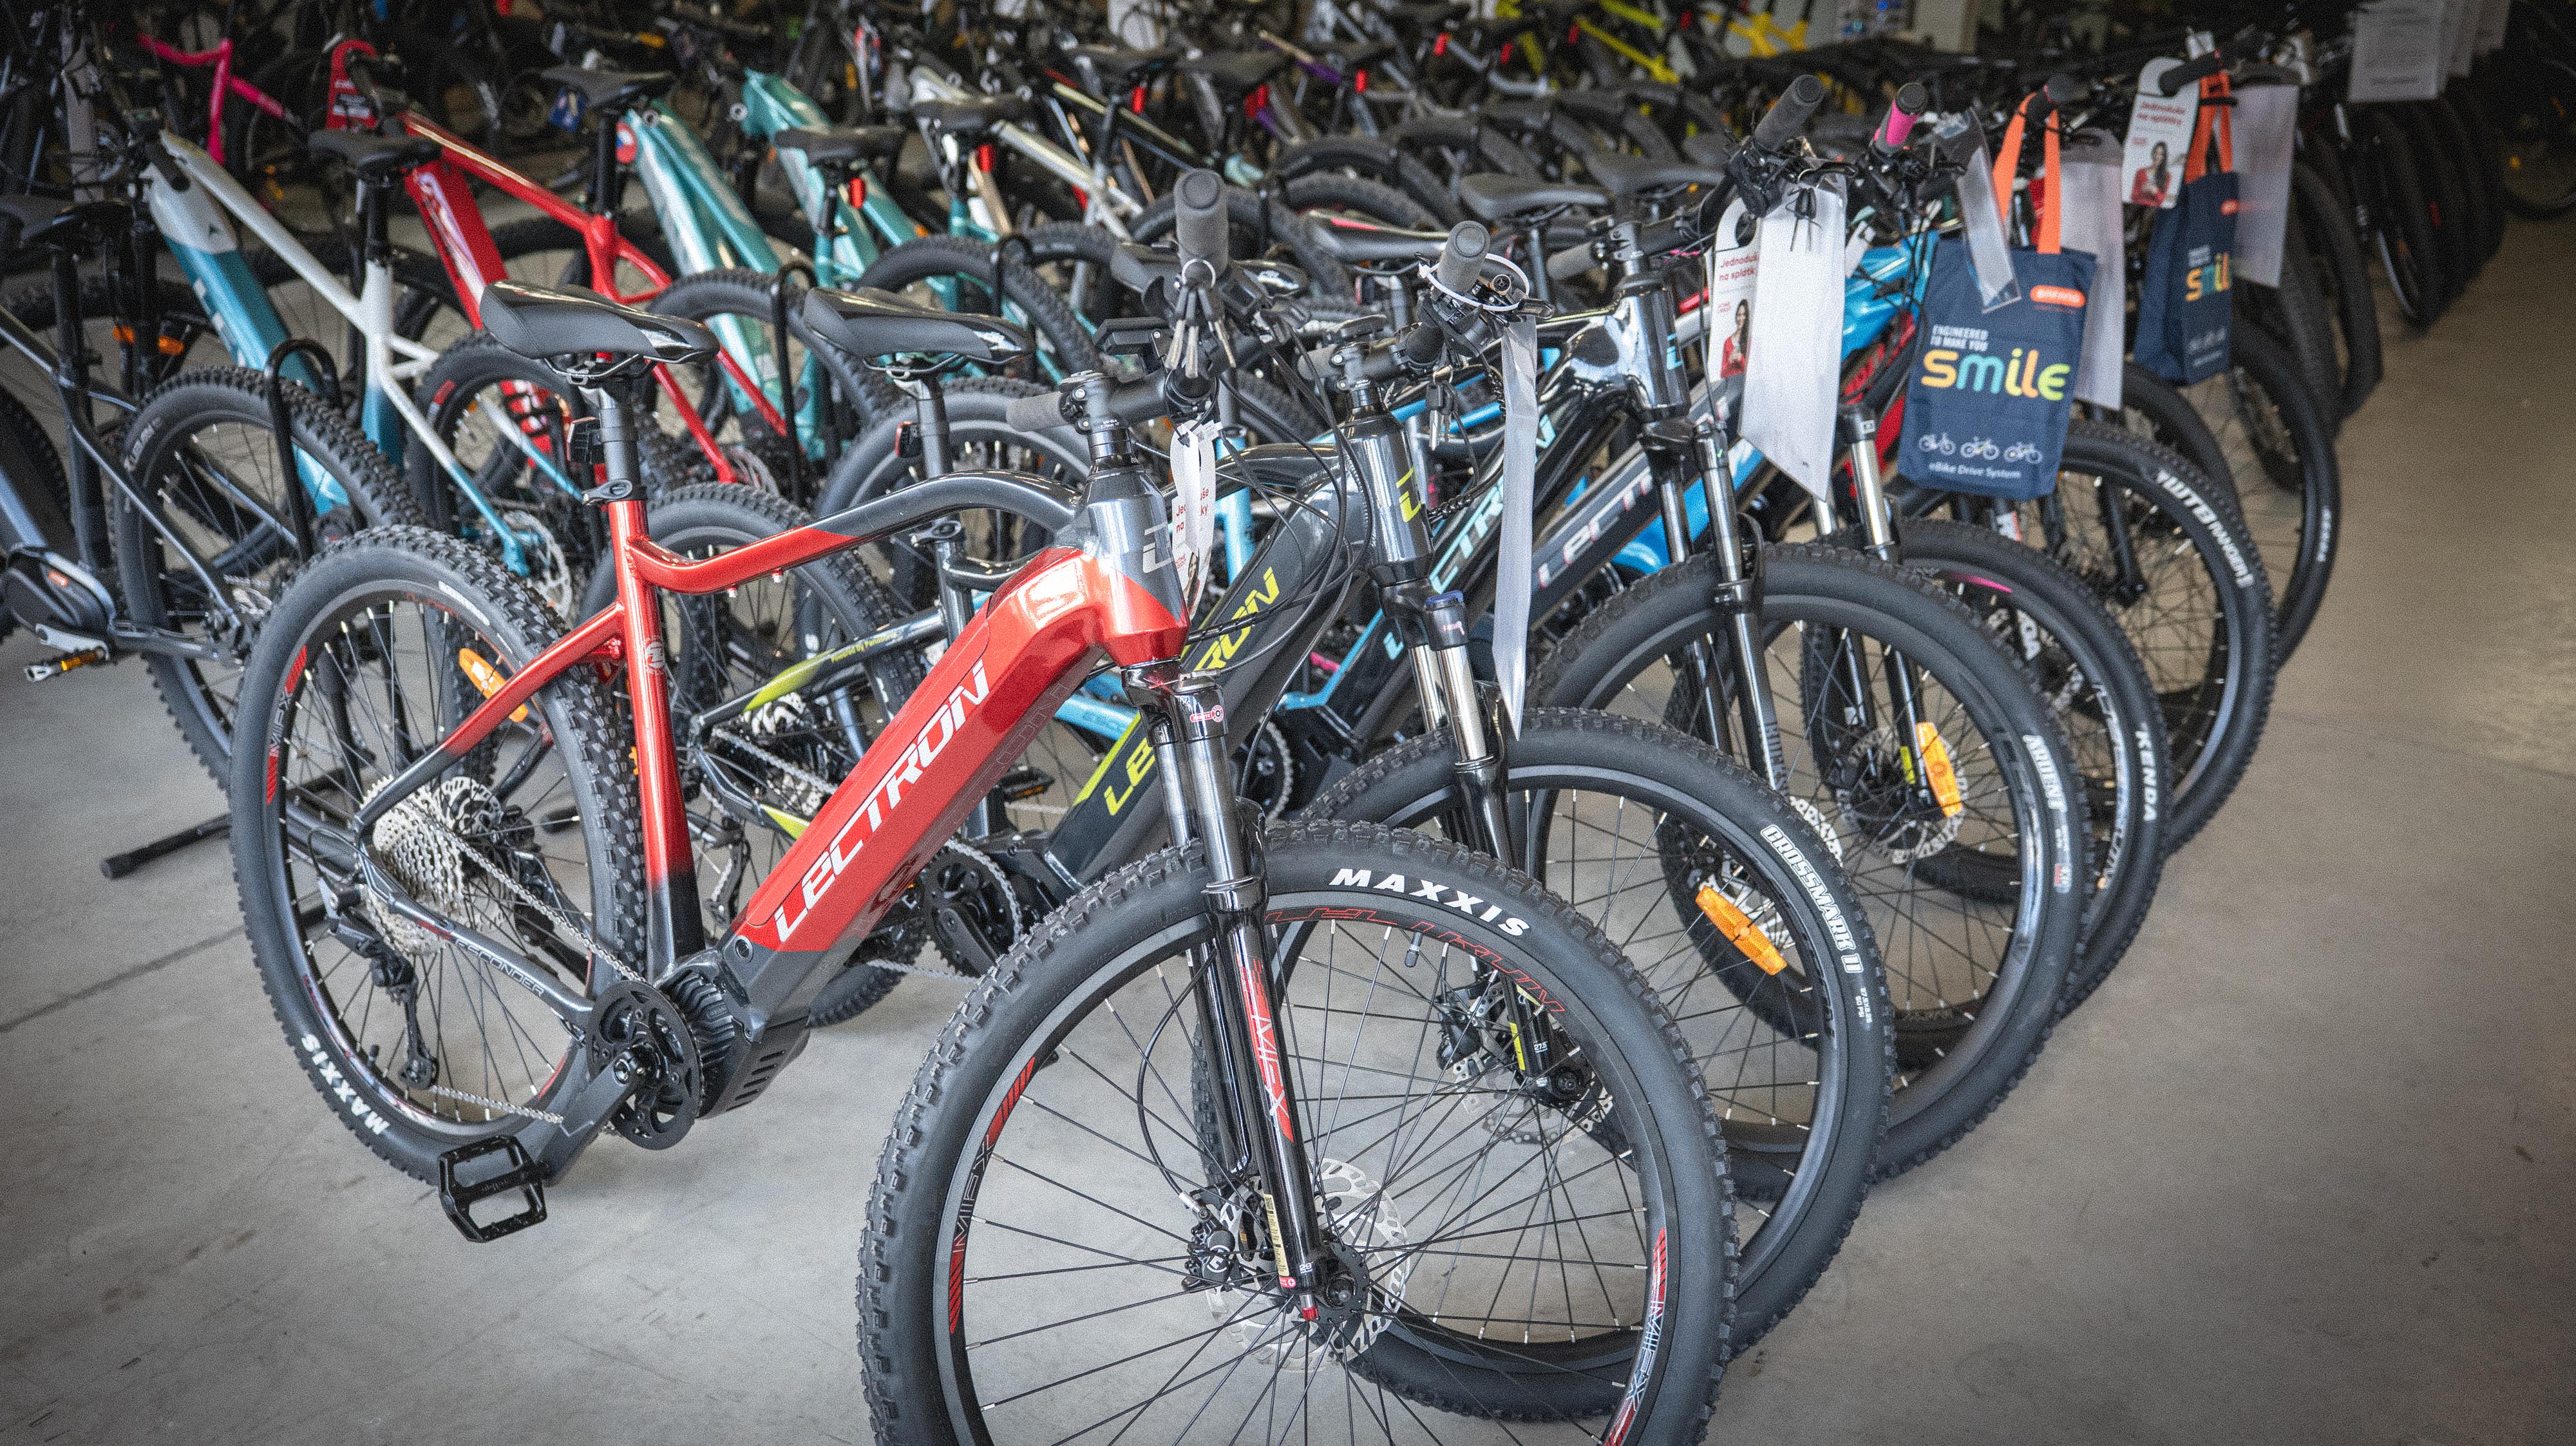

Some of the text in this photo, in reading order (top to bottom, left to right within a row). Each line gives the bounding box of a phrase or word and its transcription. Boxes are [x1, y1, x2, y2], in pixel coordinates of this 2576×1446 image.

[1933, 324, 1989, 341] ENGINEERED
[1942, 337, 1967, 350] MAKE
[1968, 339, 1989, 352] YOU
[2136, 731, 2157, 821] KENDA
[1328, 868, 1530, 937] MAXXIS
[1761, 825, 1857, 951] CROSSMARK
[301, 1033, 391, 1136] MAXXIS
